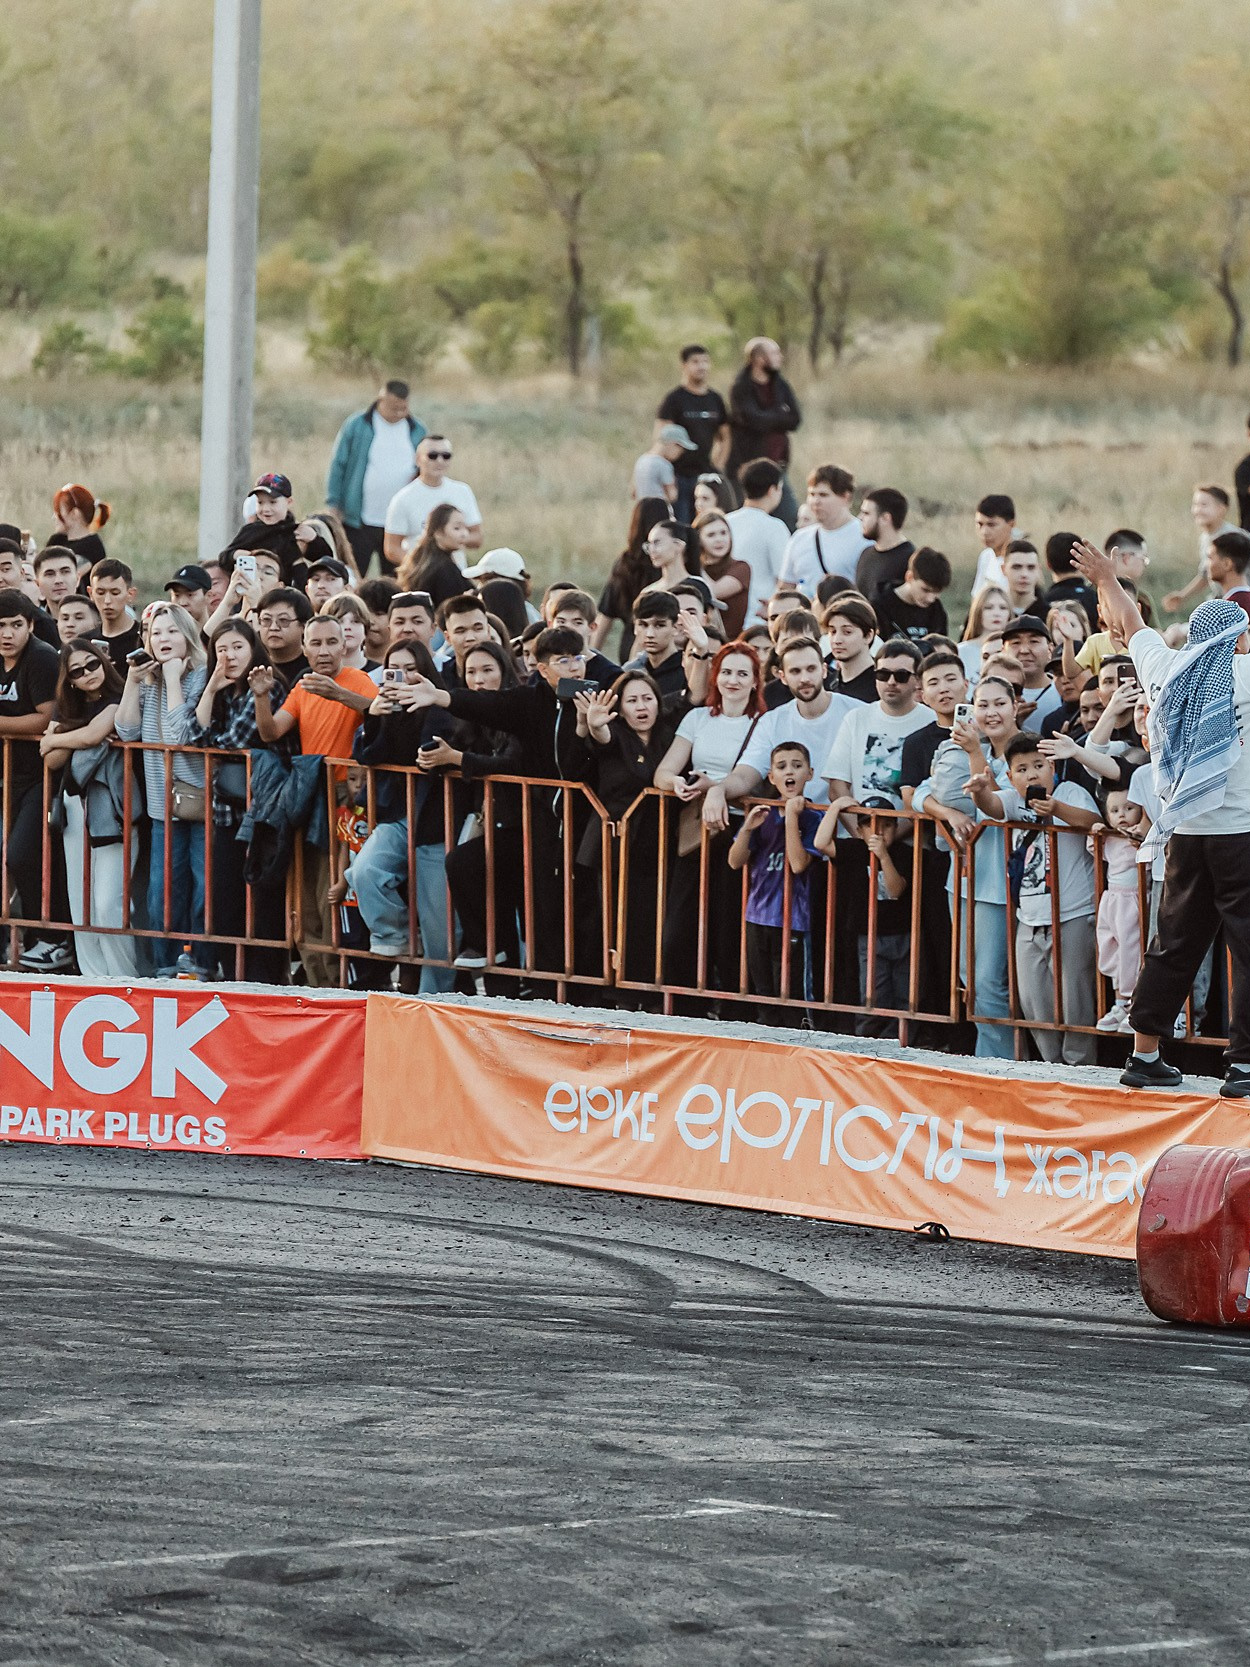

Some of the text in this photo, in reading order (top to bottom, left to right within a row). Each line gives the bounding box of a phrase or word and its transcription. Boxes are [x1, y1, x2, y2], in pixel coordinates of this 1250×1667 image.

[766, 852, 784, 871] 10
[0, 990, 231, 1105] NGK
[0, 1105, 227, 1147] PARK PLUGS
